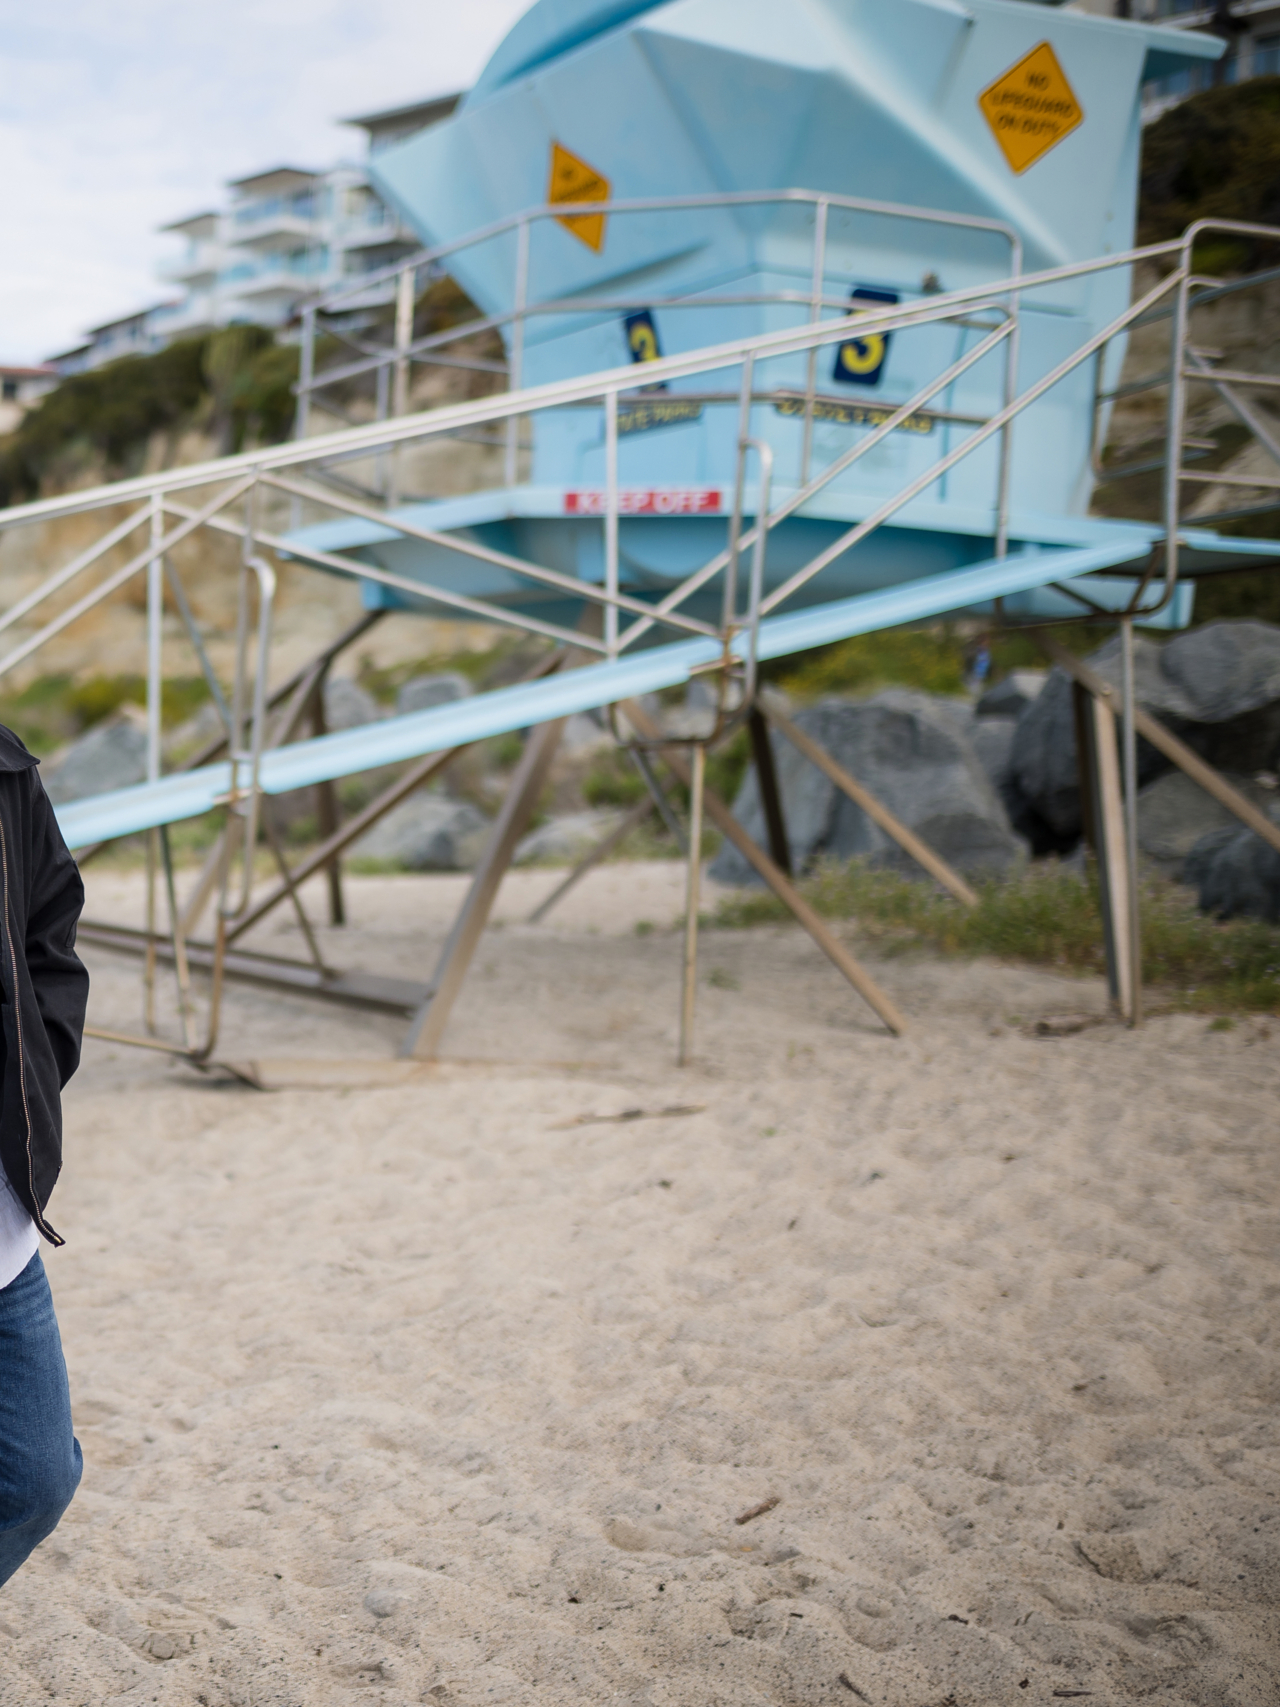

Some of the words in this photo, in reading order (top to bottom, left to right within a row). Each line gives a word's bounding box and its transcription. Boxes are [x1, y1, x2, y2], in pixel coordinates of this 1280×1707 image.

[1025, 69, 1050, 91] NO
[989, 89, 1074, 118] LIFEGUARD
[994, 110, 1018, 131] ON
[1019, 115, 1061, 137] DUTY
[841, 309, 888, 374] 3
[577, 492, 650, 515] KEP
[653, 491, 711, 515] OFF
